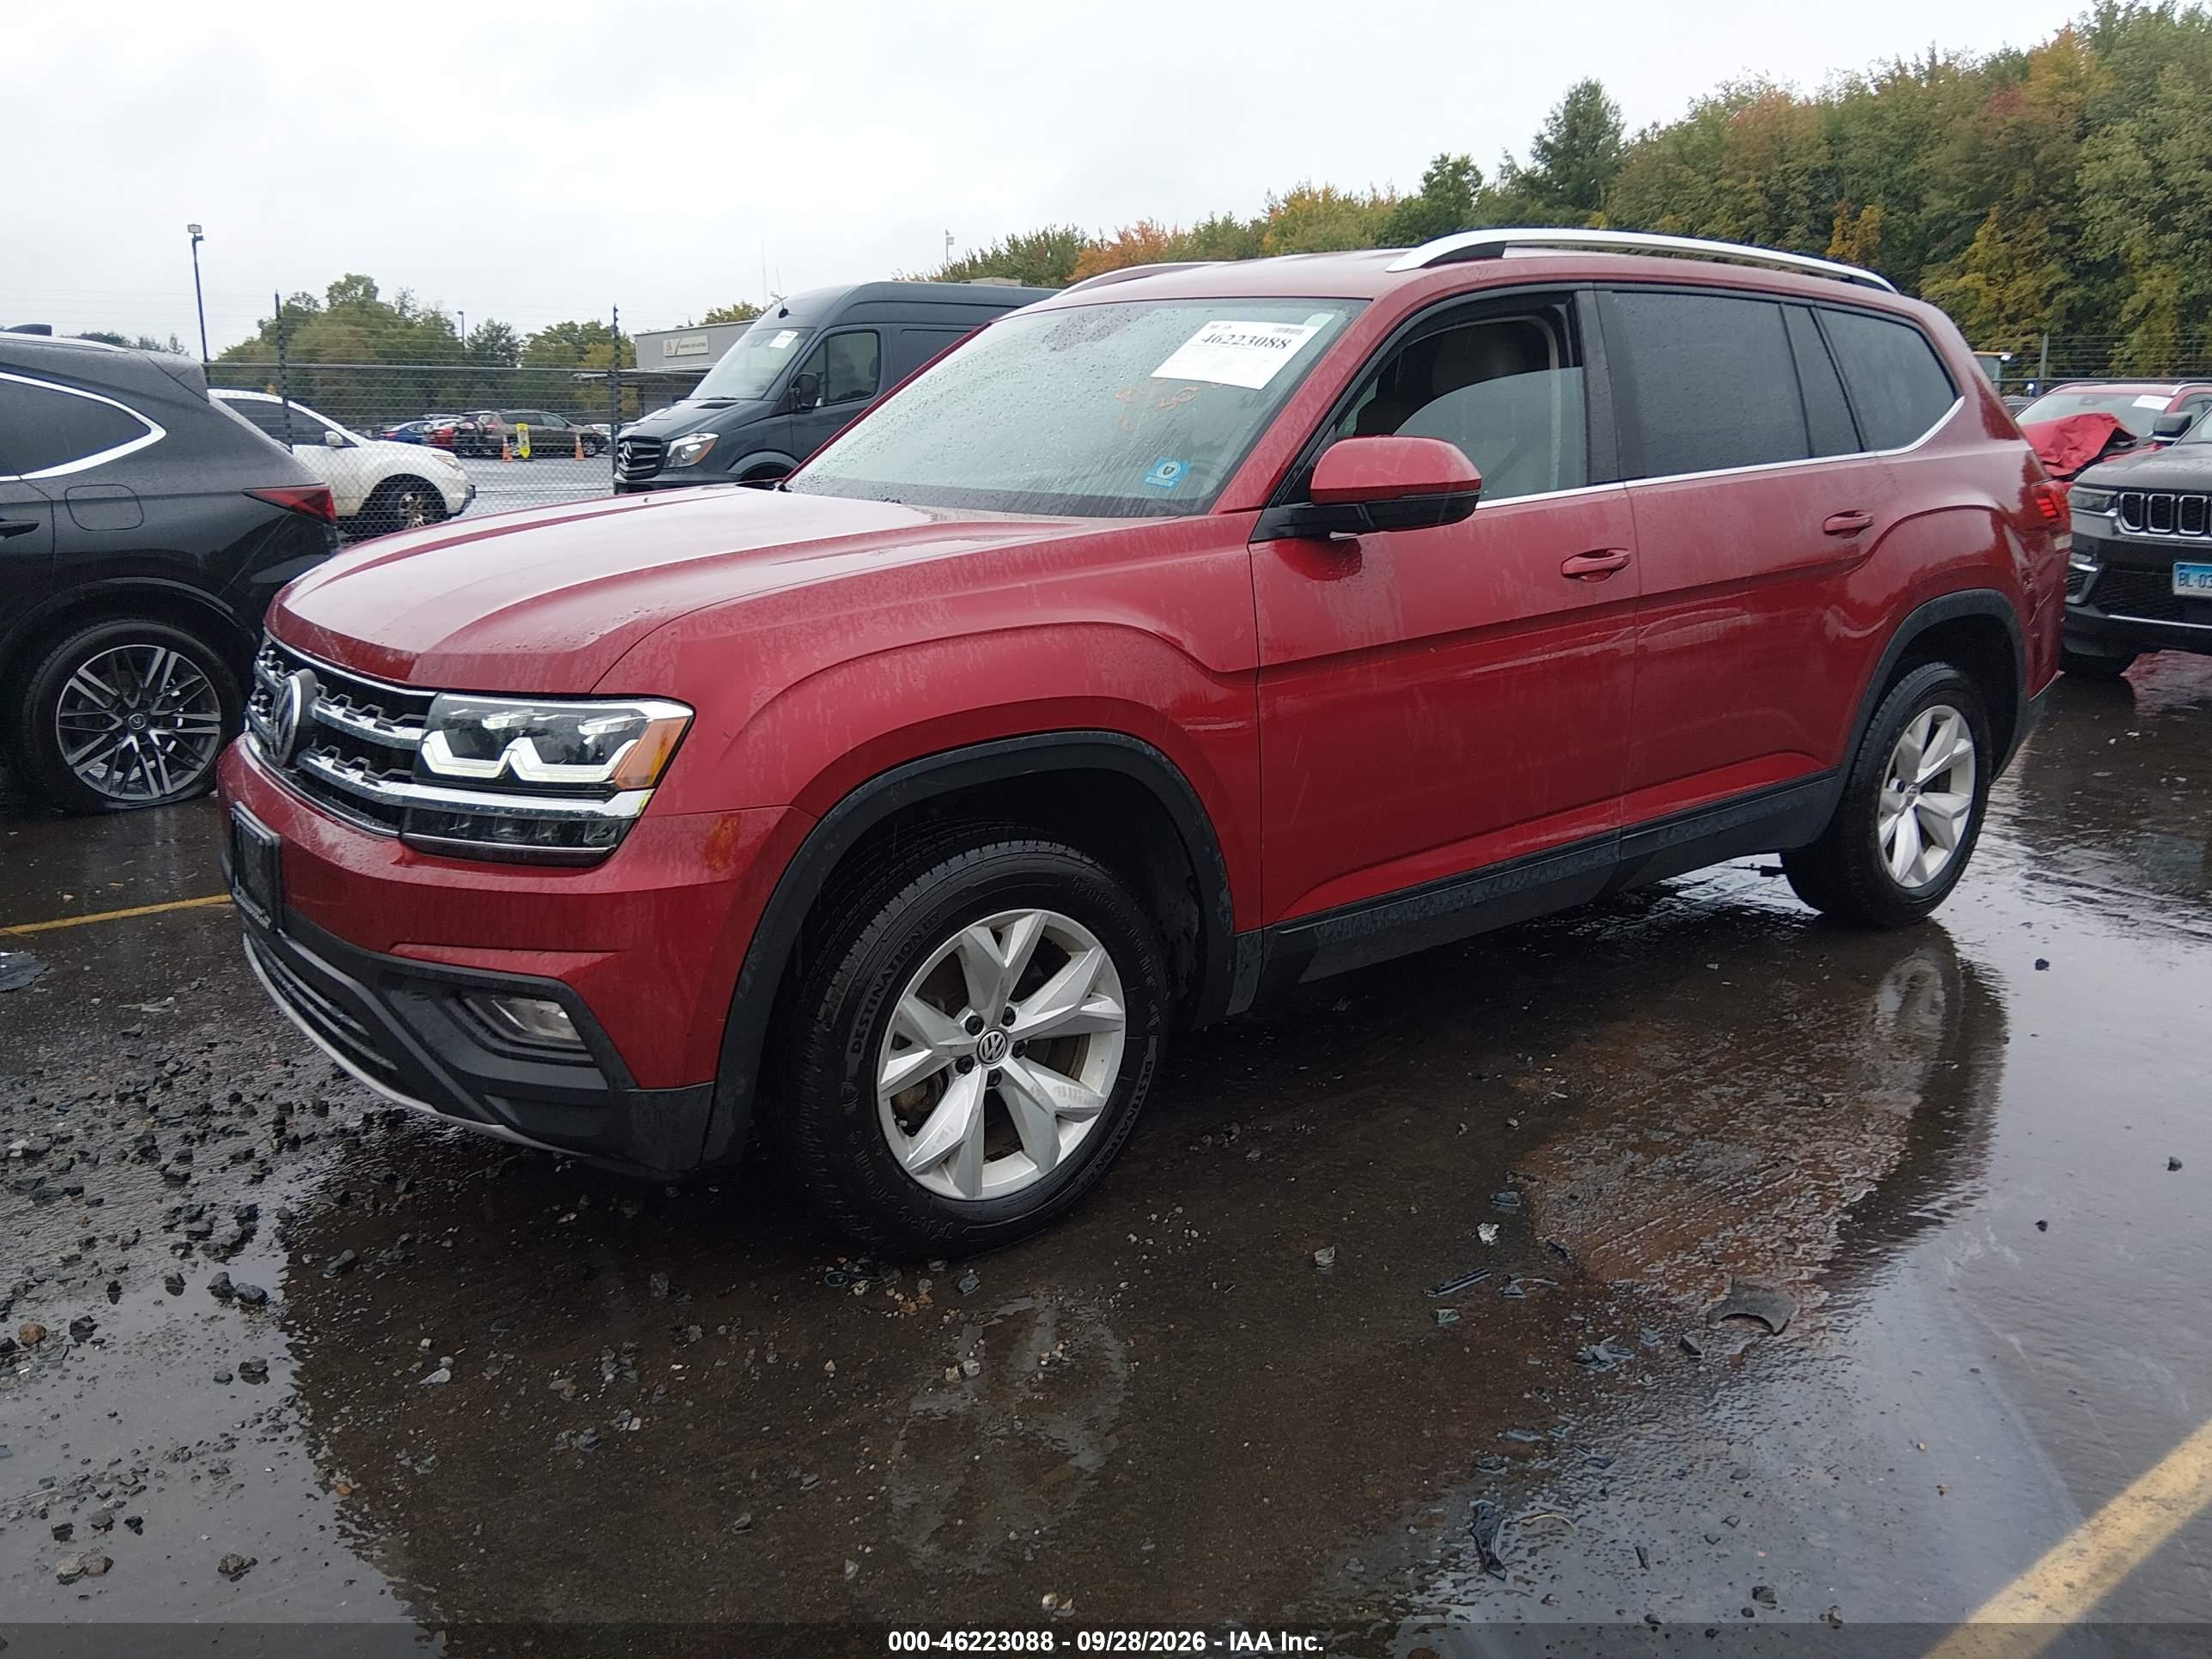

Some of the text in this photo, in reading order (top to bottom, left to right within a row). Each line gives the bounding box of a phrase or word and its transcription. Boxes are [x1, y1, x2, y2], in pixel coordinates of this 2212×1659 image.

[1200, 333, 1292, 350] 46223088
[850, 932, 923, 1054] DESTINATION
[1093, 1060, 1153, 1171] DESTINATION
